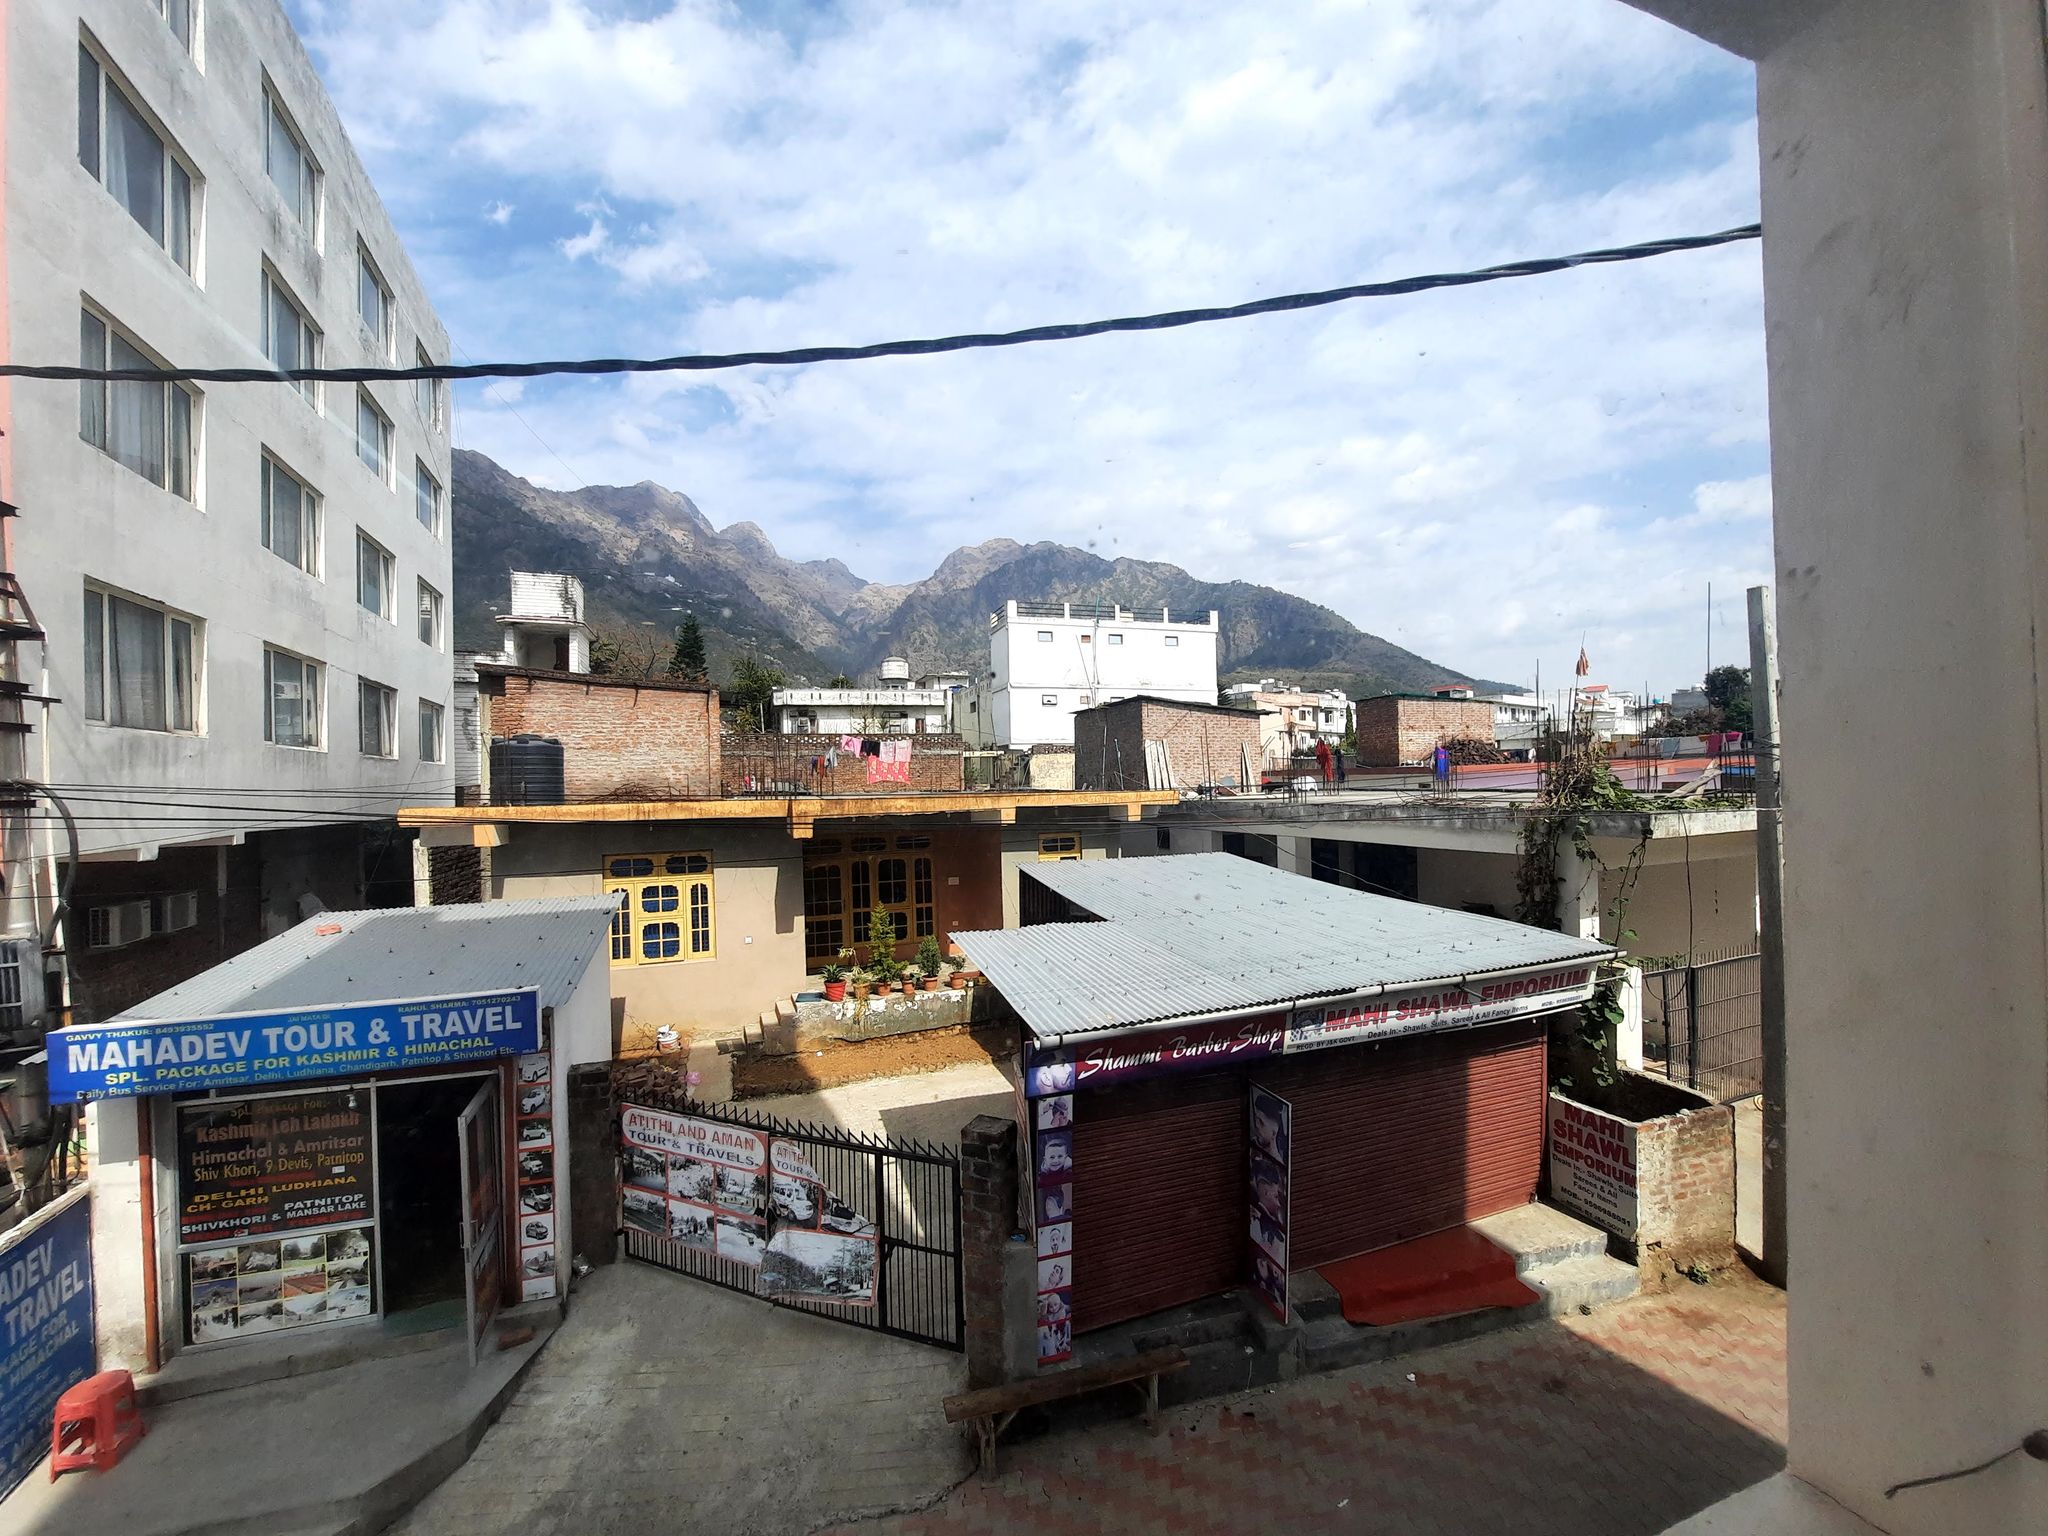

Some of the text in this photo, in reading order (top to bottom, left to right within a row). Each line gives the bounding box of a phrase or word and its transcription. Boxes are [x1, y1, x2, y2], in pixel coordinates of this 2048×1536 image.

[398, 1004, 428, 1013] RAHUL
[1325, 968, 1589, 1033] MAHI SHAWL EMPORIUM
[66, 1032, 102, 1042] GAVVY
[1367, 1029, 1388, 1040] Deals
[1452, 1014, 1474, 1025] Sarees
[1475, 1012, 1480, 1020] &
[1481, 1009, 1491, 1019] All
[1491, 1007, 1510, 1018] Fancy
[1511, 1004, 1529, 1014] Items
[68, 1005, 523, 1074] MAHADEV TOUR & TRAVEL
[1077, 1023, 1281, 1080] Shammi Barber Shop
[76, 1088, 107, 1100] Daily
[108, 1087, 131, 1096] Bus
[134, 1082, 176, 1094] Service
[401, 1055, 442, 1068] Patnitop
[444, 1053, 451, 1062] &
[453, 1047, 498, 1060] Shivkhori
[105, 1071, 148, 1085] SPL.
[156, 1058, 247, 1080] PACKAGE
[253, 1054, 290, 1071] FOR
[297, 1049, 380, 1066] KASHMIR
[386, 1046, 398, 1057] &
[405, 1036, 494, 1055] HIMACHAL
[196, 1110, 361, 1144] Kashmir Leh Ladakh
[678, 1122, 707, 1141] AND
[711, 1131, 757, 1152] AMAN
[1564, 1102, 1625, 1143] MAHI
[192, 1133, 365, 1166] Himachal & Amritsar
[629, 1129, 667, 1146] TOUR
[672, 1140, 681, 1149] &
[1553, 1119, 1637, 1170] SHAWL
[193, 1166, 219, 1183] Shiv
[265, 1160, 273, 1173] 9
[317, 1151, 365, 1168] Patnitop
[776, 1160, 803, 1175] TOUR
[1552, 1153, 1572, 1168] Deals
[1553, 1139, 1637, 1188] EMPORIUM
[192, 1186, 265, 1204] DELHI
[271, 1175, 358, 1194] LUDHIANA
[1573, 1172, 1618, 1199] Sarees & All
[1573, 1181, 1618, 1208] Fancy Items
[220, 1196, 271, 1209] GARH
[284, 1193, 364, 1212] PATNITOP
[286, 1204, 336, 1220] MANSAR
[337, 1200, 367, 1214] LAKE
[181, 1213, 267, 1235] SHIVKHORI
[271, 1212, 282, 1222] &
[5, 1260, 85, 1346] TRAVEL
[10, 1320, 80, 1391] HIMACHAL
